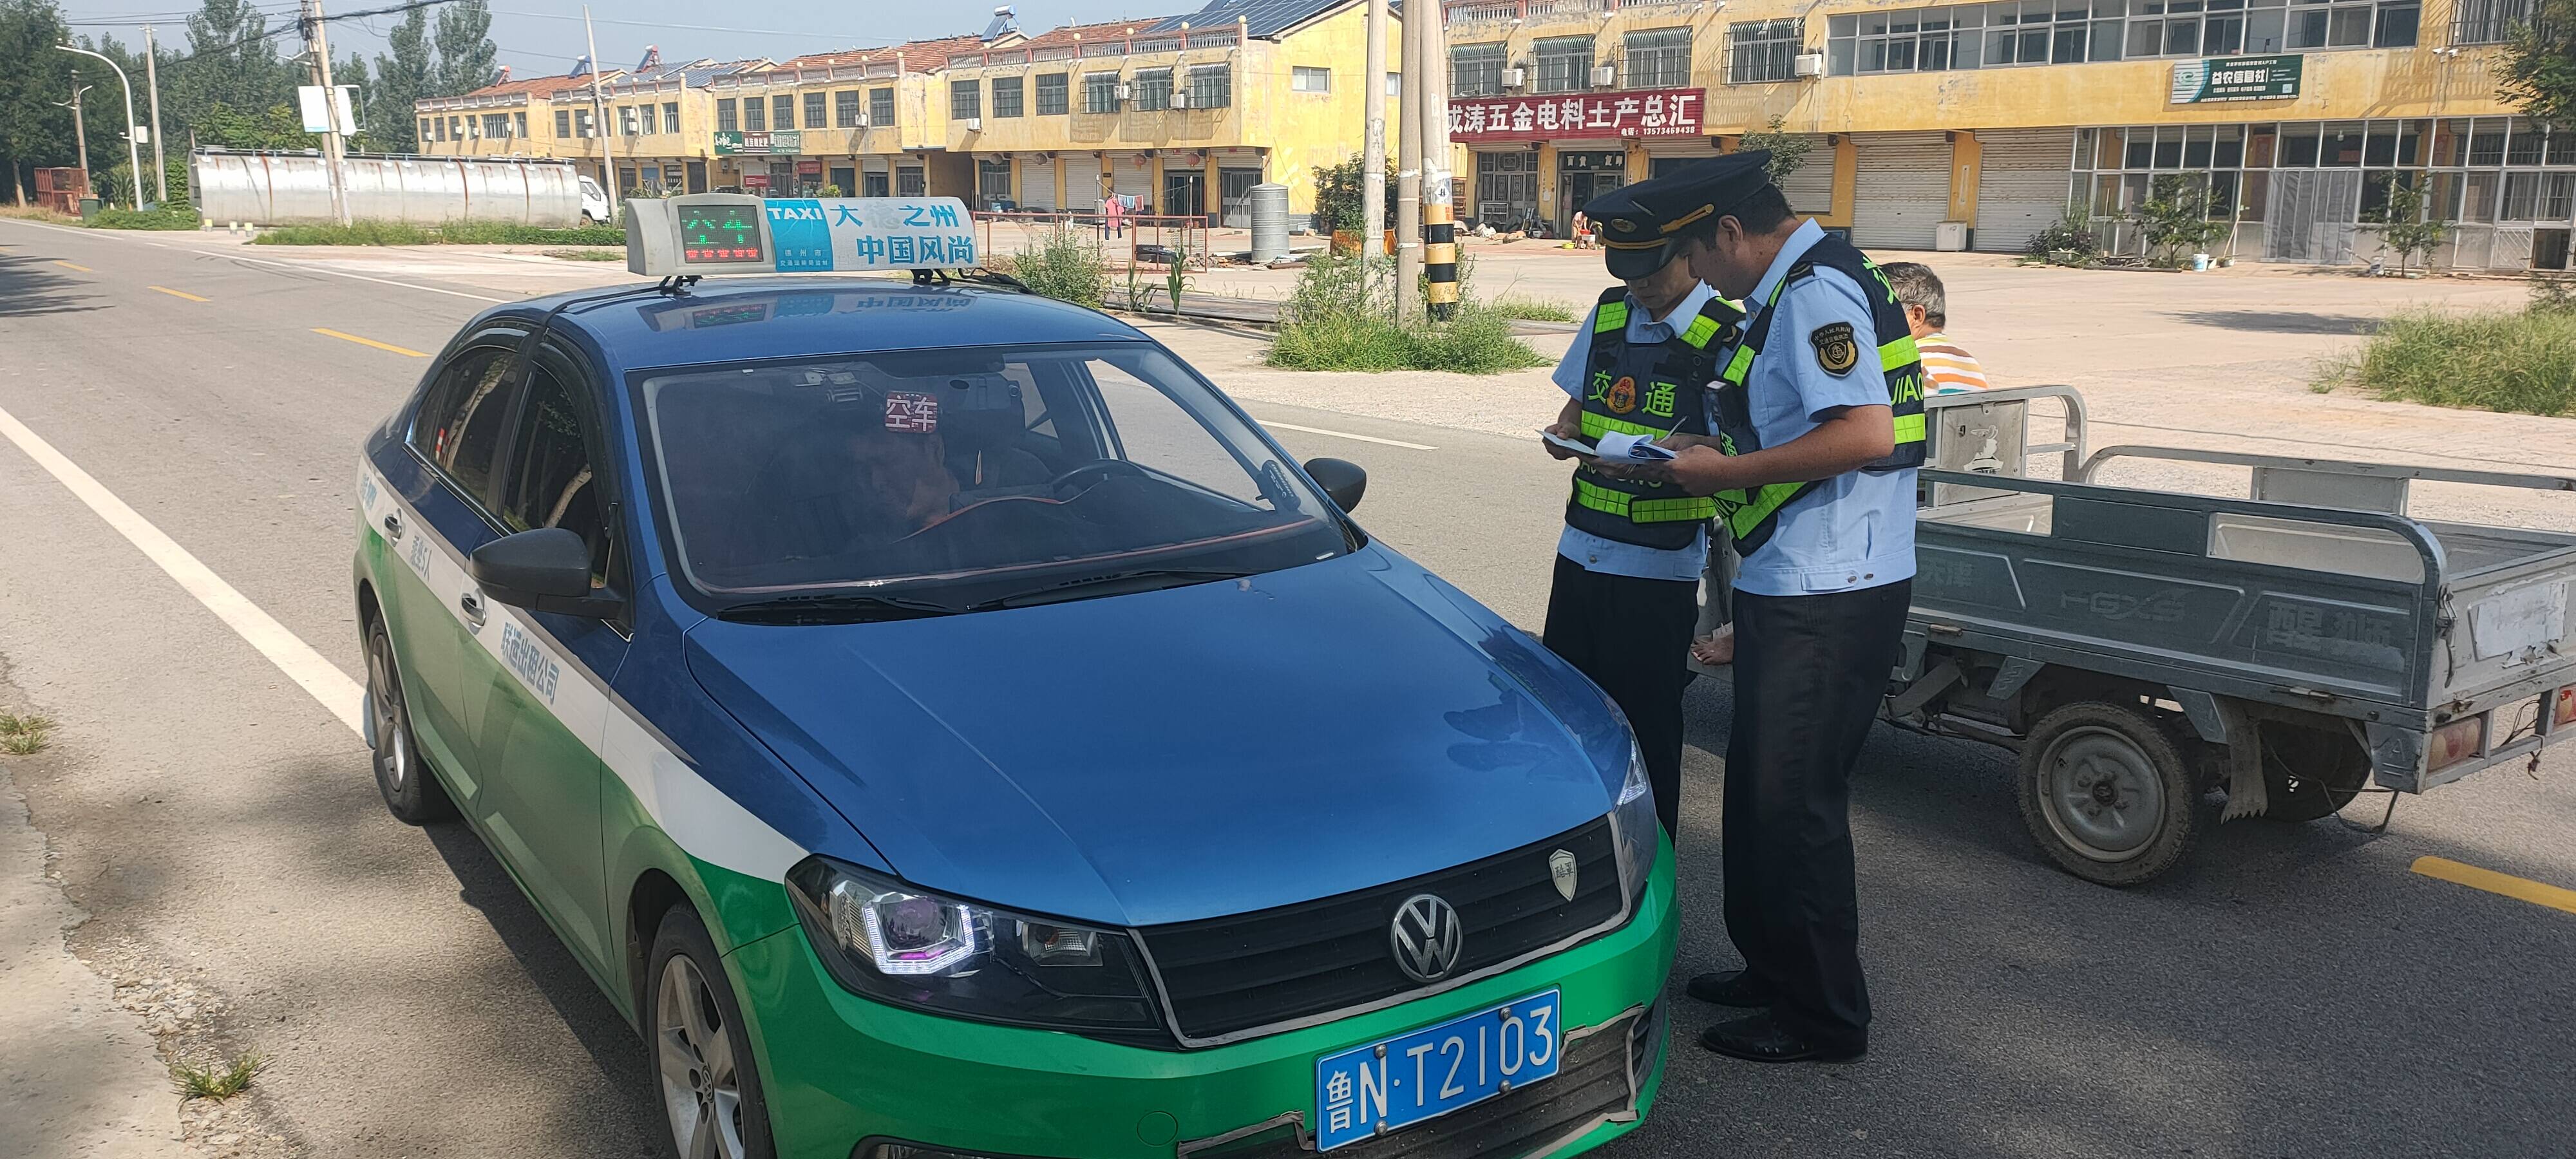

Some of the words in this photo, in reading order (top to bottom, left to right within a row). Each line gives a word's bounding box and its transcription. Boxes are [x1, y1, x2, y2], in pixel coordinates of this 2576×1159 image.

[2211, 69, 2266, 85] 益农信息社
[767, 207, 823, 221] TAXI
[856, 234, 974, 265] 中国风尚
[885, 395, 938, 431] 空车
[1325, 1004, 1553, 1134] 鲁N·T2103
